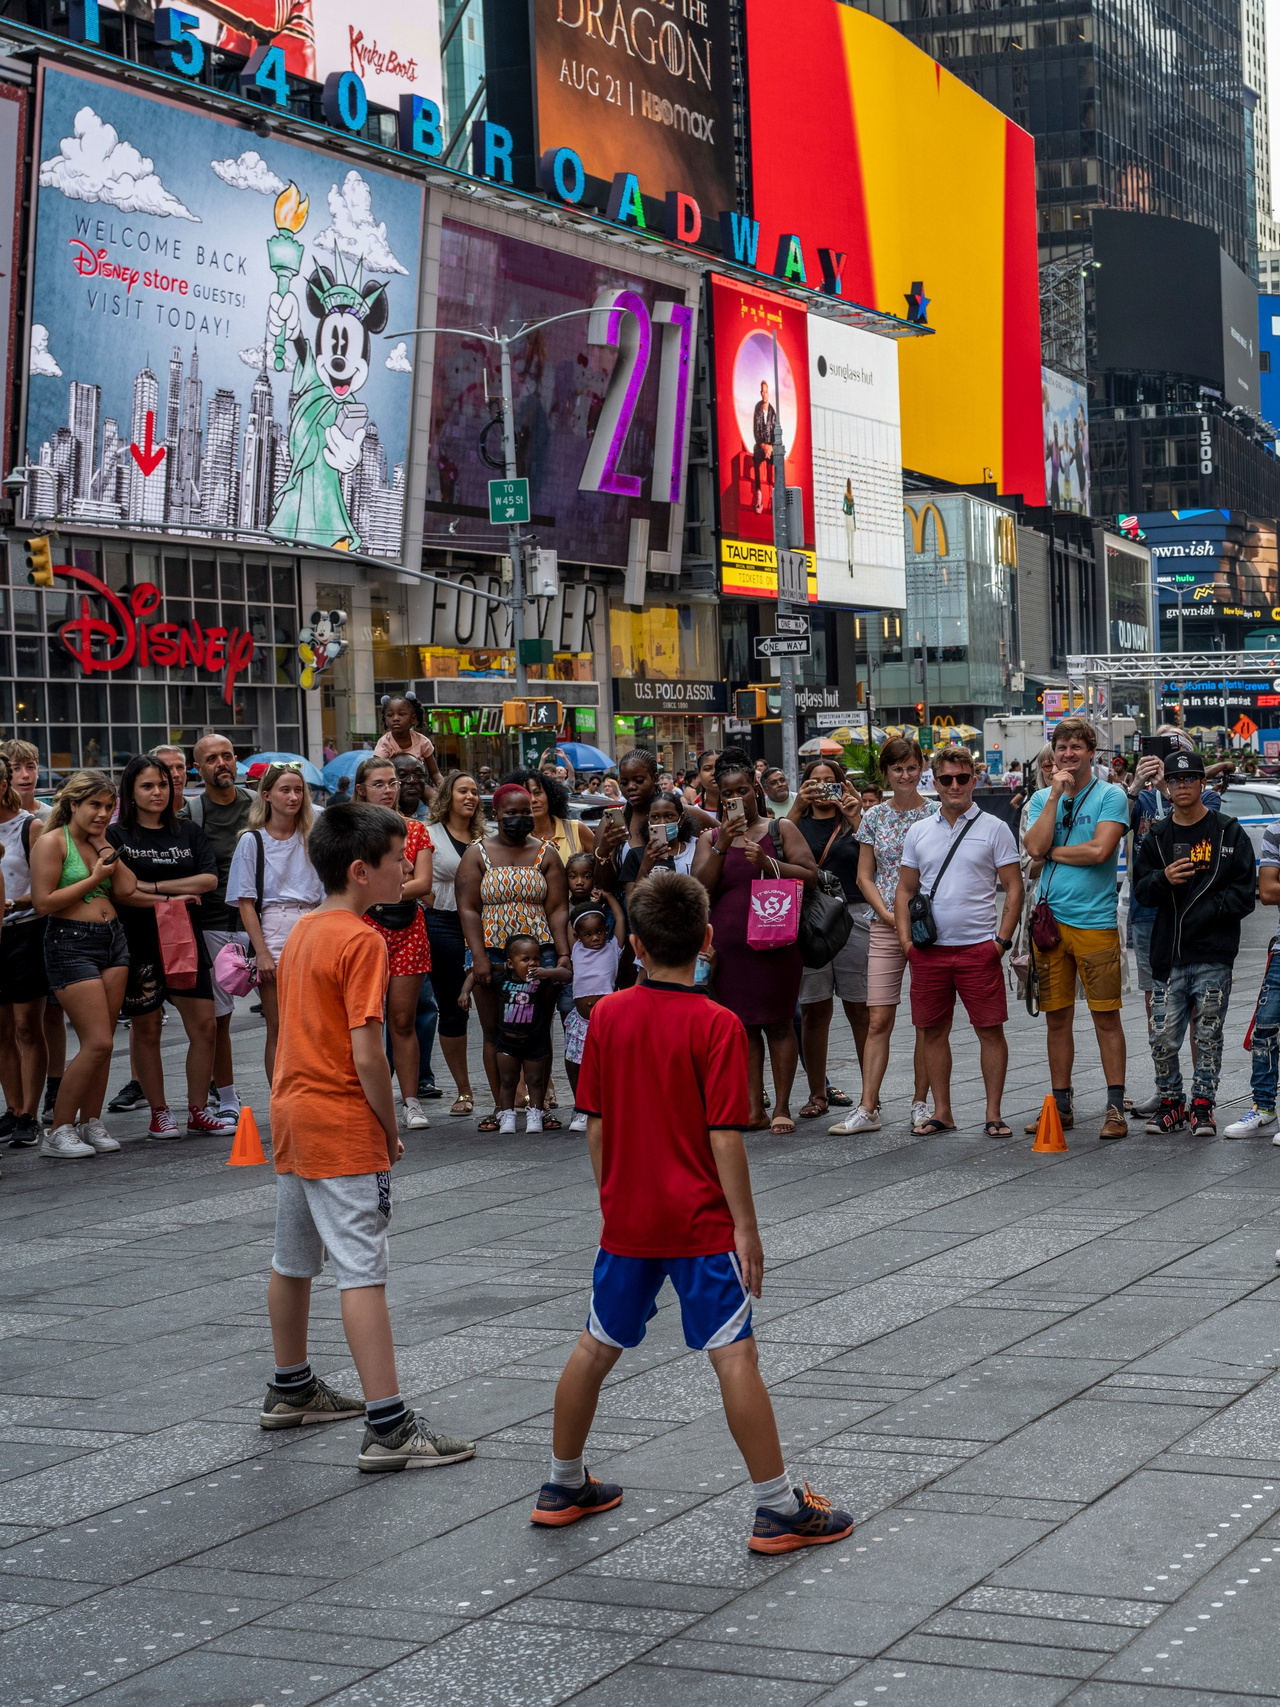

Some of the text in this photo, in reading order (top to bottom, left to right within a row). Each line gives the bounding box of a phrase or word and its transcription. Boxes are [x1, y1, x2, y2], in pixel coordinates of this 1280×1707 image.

[348, 24, 419, 82] Kinky Boots
[560, 58, 599, 96] AUG
[606, 75, 621, 106] 21
[75, 214, 248, 277] WELCOME BACK
[143, 272, 189, 297] store
[193, 283, 246, 309] GUESTS!
[87, 289, 231, 339] VISIT TODAY!
[829, 360, 874, 386] sunglass hut
[596, 288, 695, 503] 21
[1200, 416, 1212, 474] 1500
[504, 484, 514, 493] TO
[495, 496, 524, 506] W 45 St
[726, 545, 772, 564] TAUREN
[738, 572, 774, 586] TICKETS ON
[430, 572, 598, 652] FORVER
[781, 620, 804, 630] ONE WAY
[764, 642, 804, 652] ONE WAY
[634, 682, 716, 701] U.S. POLO ASSN.
[1244, 682, 1270, 690] crews
[795, 688, 840, 712] nglass hut
[1191, 696, 1218, 705] in 1st
[504, 1004, 534, 1023] WIN
